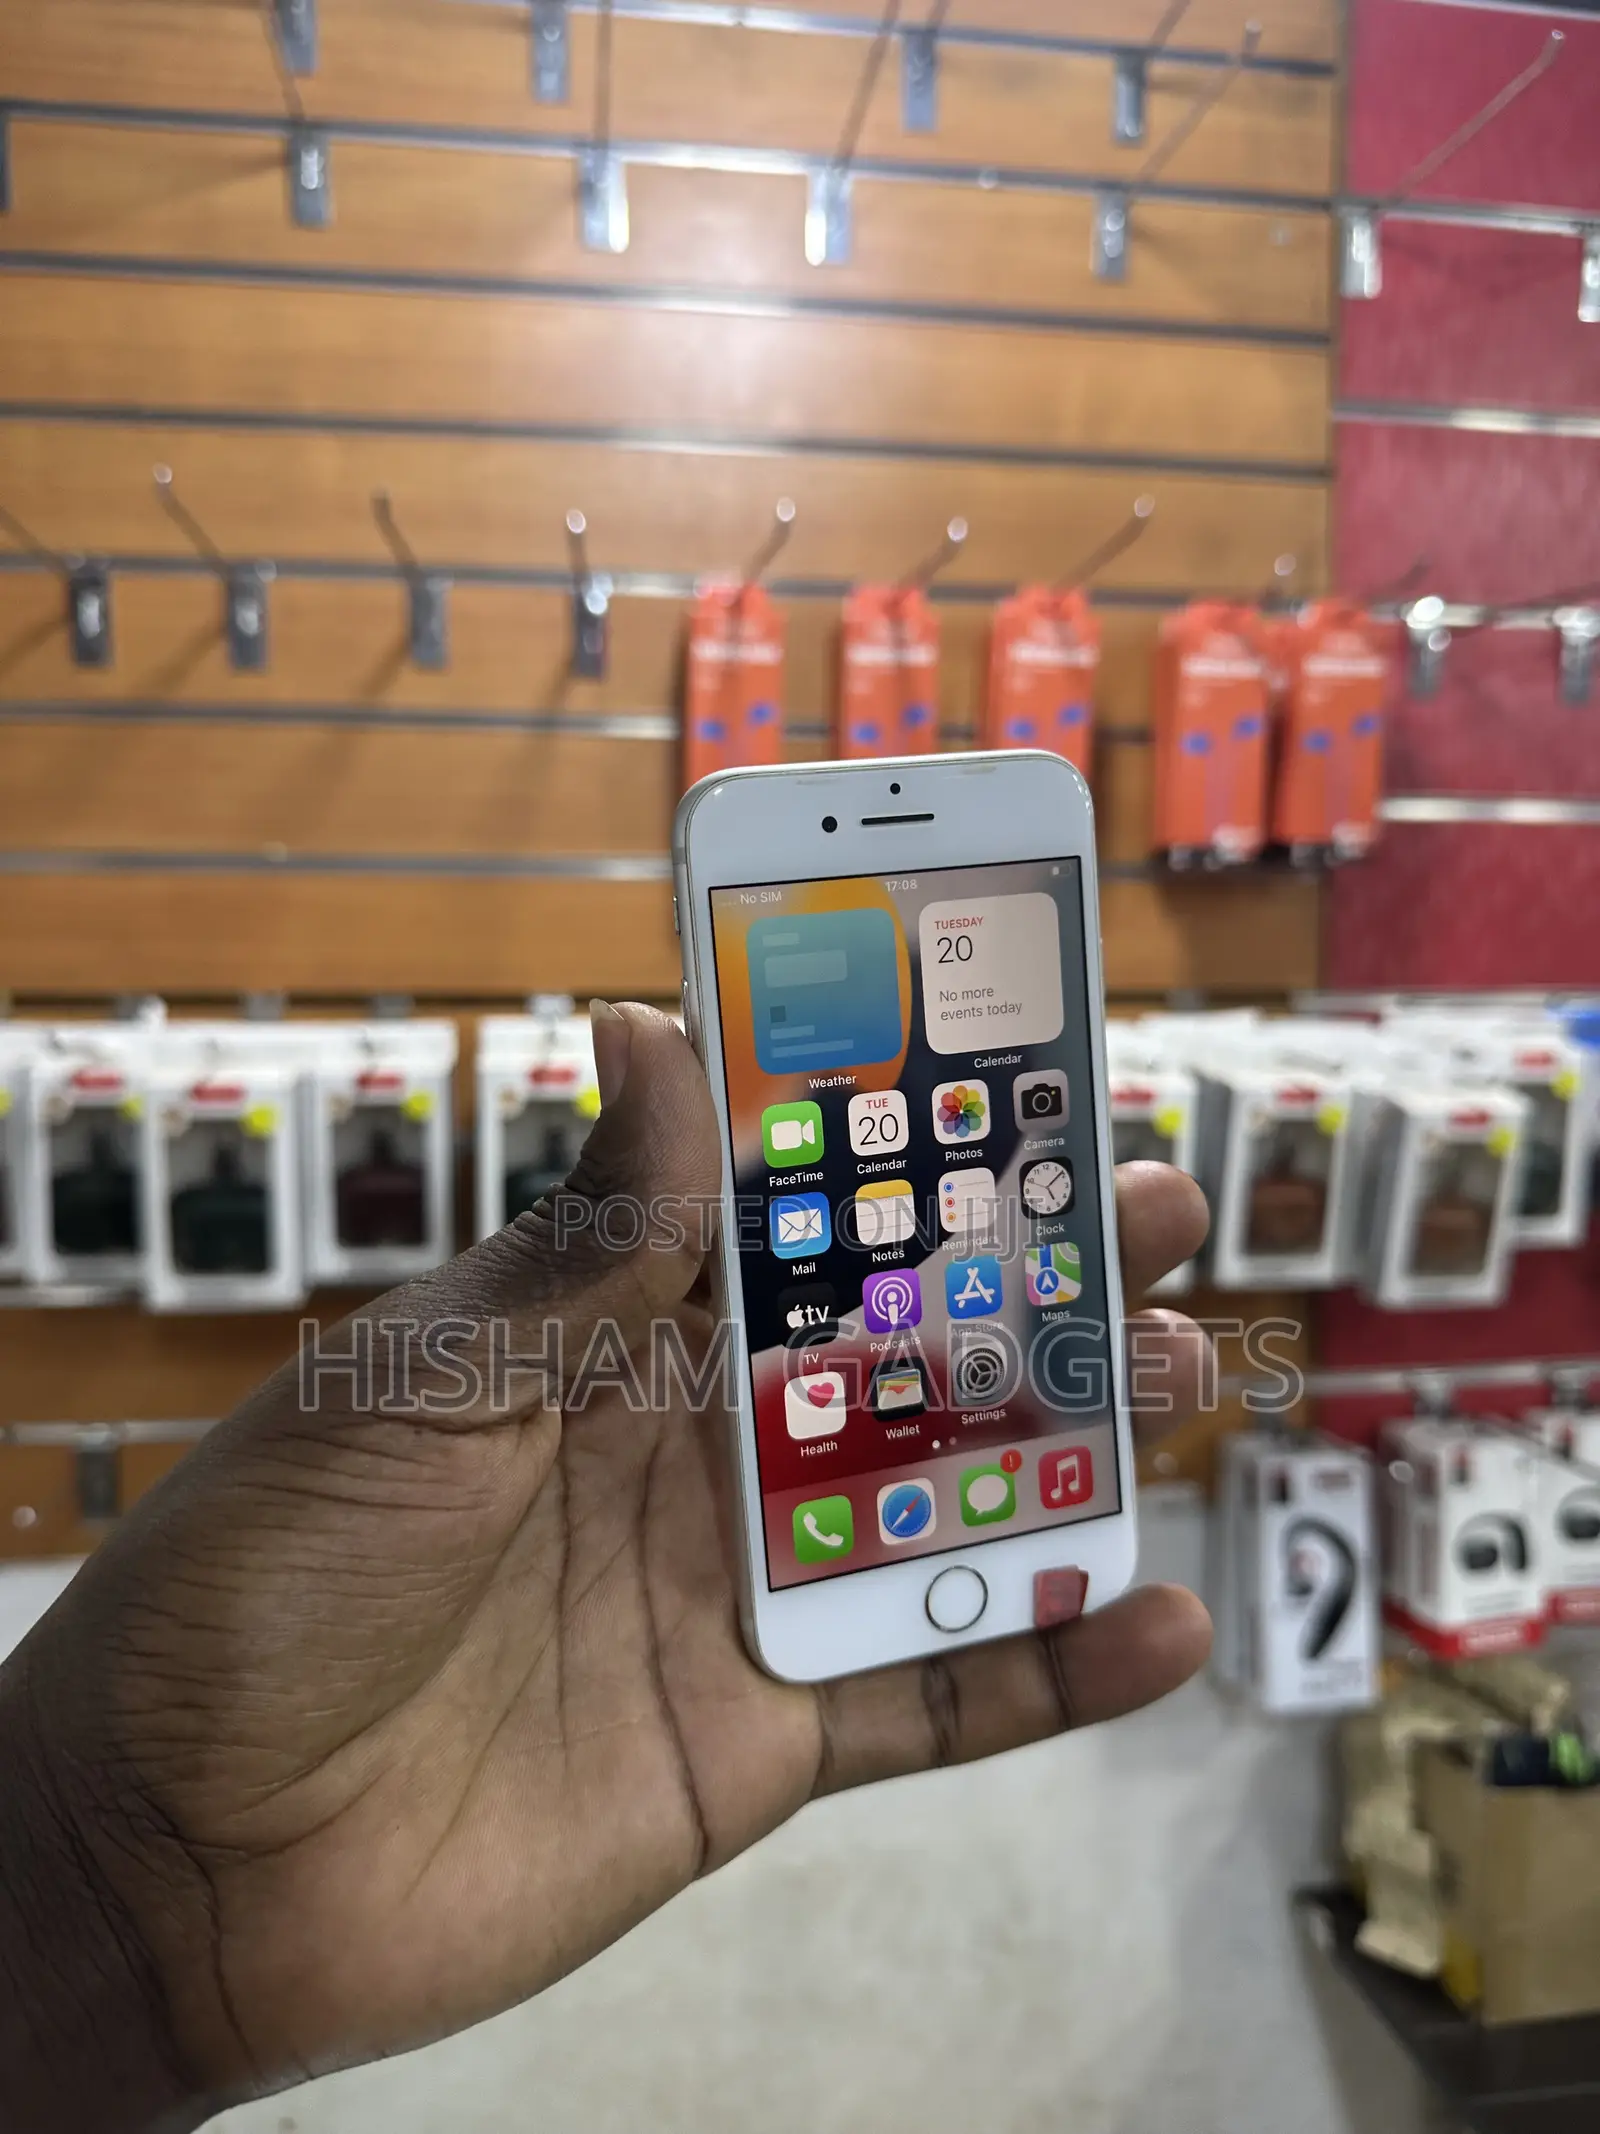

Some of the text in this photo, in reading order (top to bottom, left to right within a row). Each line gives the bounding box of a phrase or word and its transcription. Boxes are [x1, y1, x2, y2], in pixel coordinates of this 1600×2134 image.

[884, 879, 918, 892] 17:08
[740, 891, 782, 904] No SIM
[934, 916, 984, 930] TUESDAY
[936, 935, 973, 963] 20
[939, 987, 994, 1002] No more
[940, 1001, 1023, 1021] events today
[974, 1054, 1022, 1069] Calendar
[808, 1075, 857, 1089] Weather
[865, 1098, 889, 1110] TUE
[858, 1113, 899, 1146] 20
[1023, 1137, 1065, 1150] Camera
[945, 1148, 983, 1161] Photos
[856, 1159, 907, 1175] Calendar
[768, 1171, 824, 1187] FaceTime
[1035, 1222, 1065, 1236] Clock
[872, 1249, 905, 1262] Notes
[792, 1262, 816, 1275] Mail
[805, 1304, 829, 1325] tv
[1041, 1309, 1071, 1322] Maps
[870, 1335, 921, 1352] Podcasts
[804, 1352, 819, 1365] TV
[961, 1407, 1006, 1425] Settings
[885, 1424, 920, 1440] Wallet
[800, 1441, 838, 1457] Health
